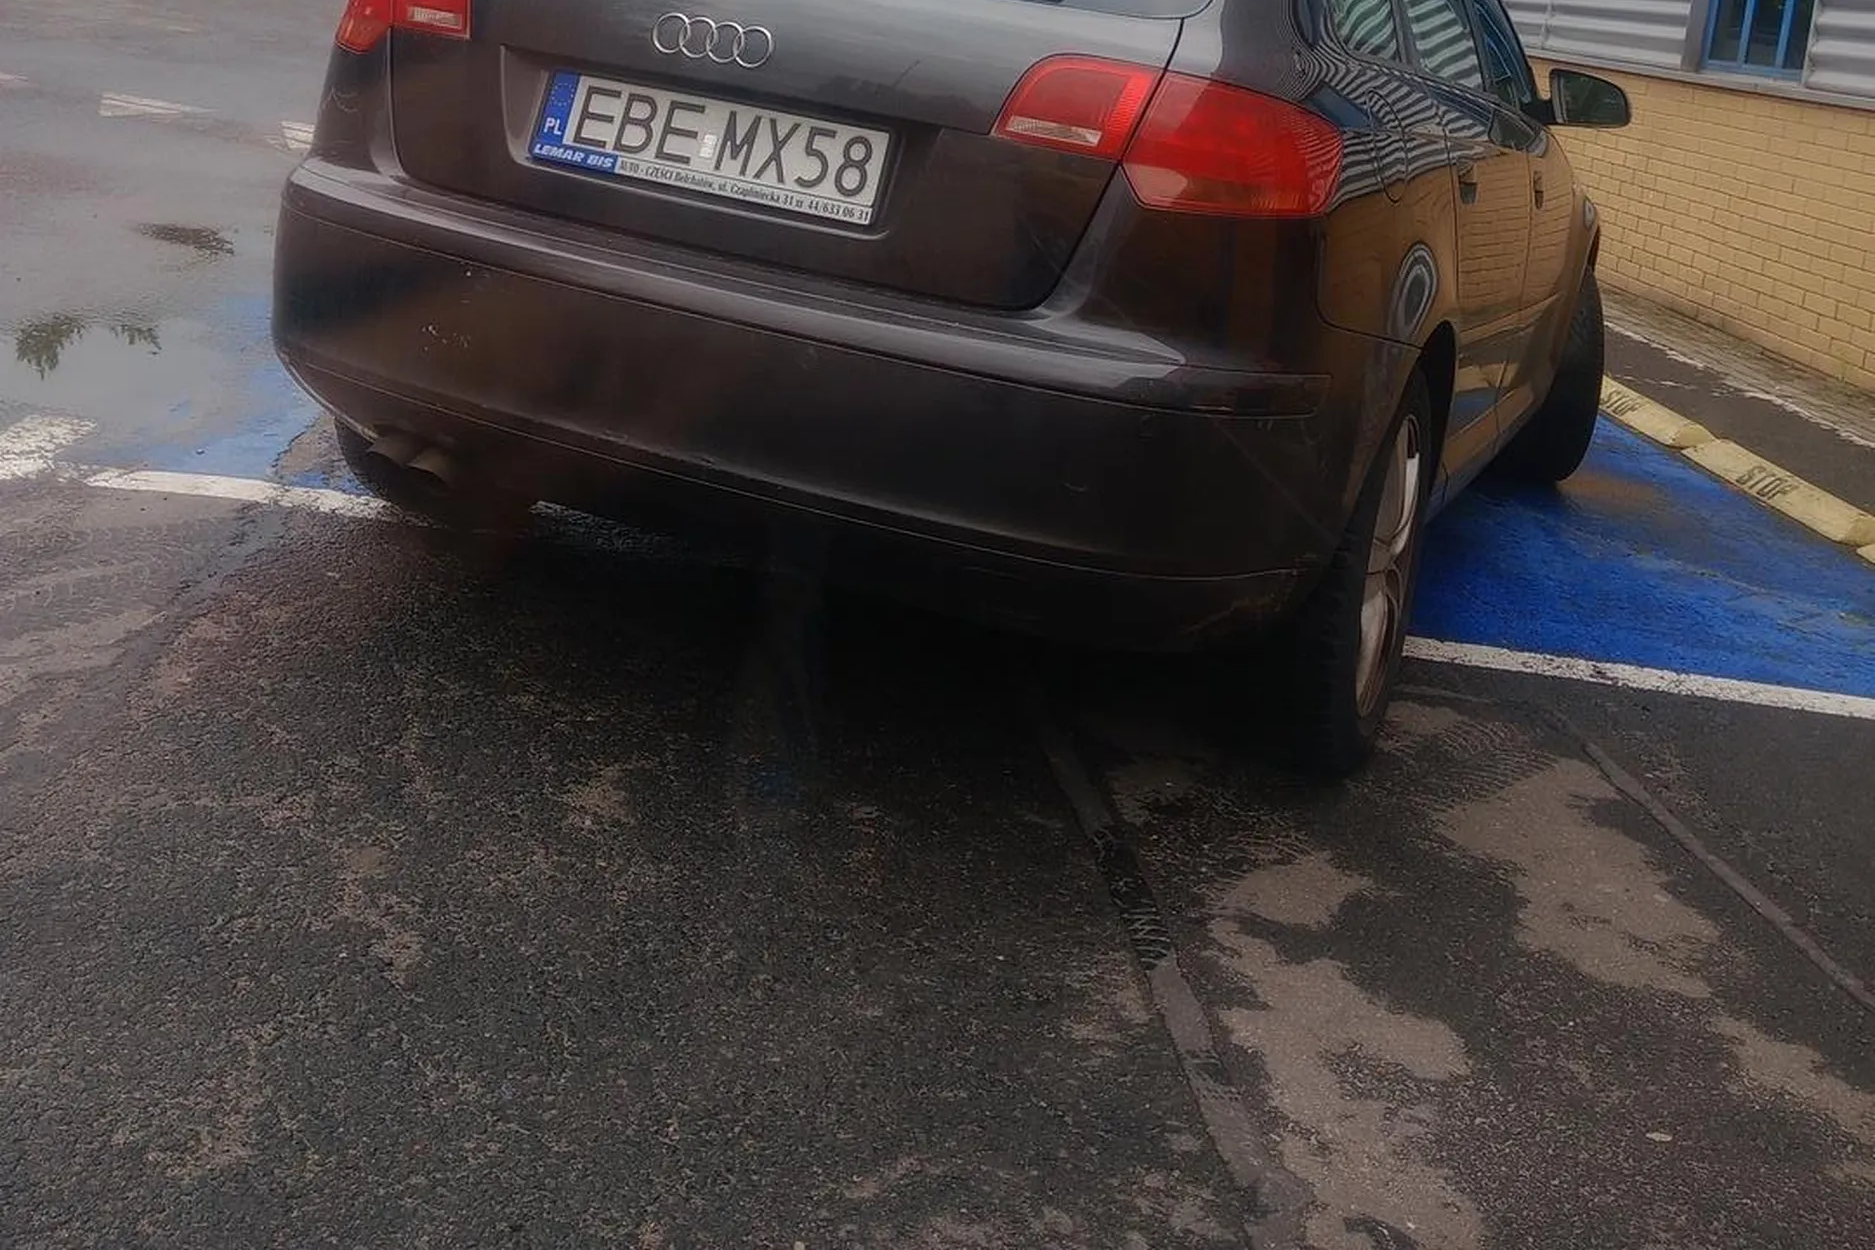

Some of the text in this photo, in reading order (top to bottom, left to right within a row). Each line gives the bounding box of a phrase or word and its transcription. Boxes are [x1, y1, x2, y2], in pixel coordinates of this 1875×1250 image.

[543, 117, 562, 136] PL
[573, 85, 873, 197] EBE MX58
[534, 144, 614, 169] LEMAR BIS
[782, 193, 795, 207] 31
[1599, 388, 1642, 418] STOP
[1735, 464, 1797, 502] STOP
